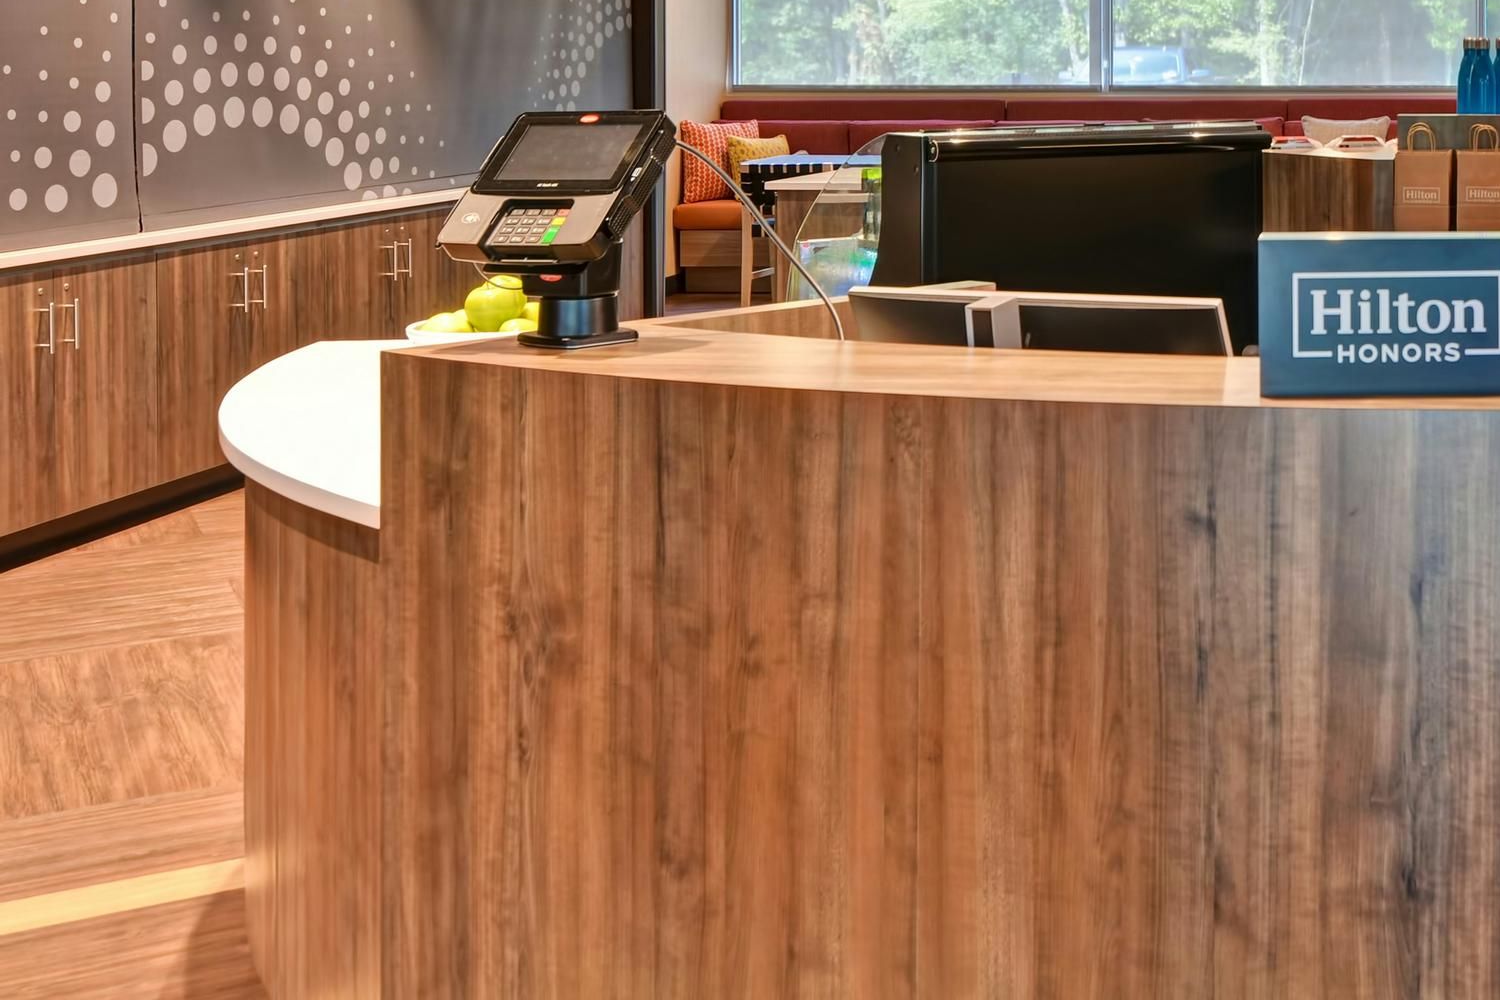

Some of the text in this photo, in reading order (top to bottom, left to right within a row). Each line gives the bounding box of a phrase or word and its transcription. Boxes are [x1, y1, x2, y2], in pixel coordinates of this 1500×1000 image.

[1406, 189, 1437, 200] Hilton
[1469, 188, 1500, 199] Hilton
[1310, 288, 1487, 335] Hilton
[1337, 342, 1461, 364] HONORS
